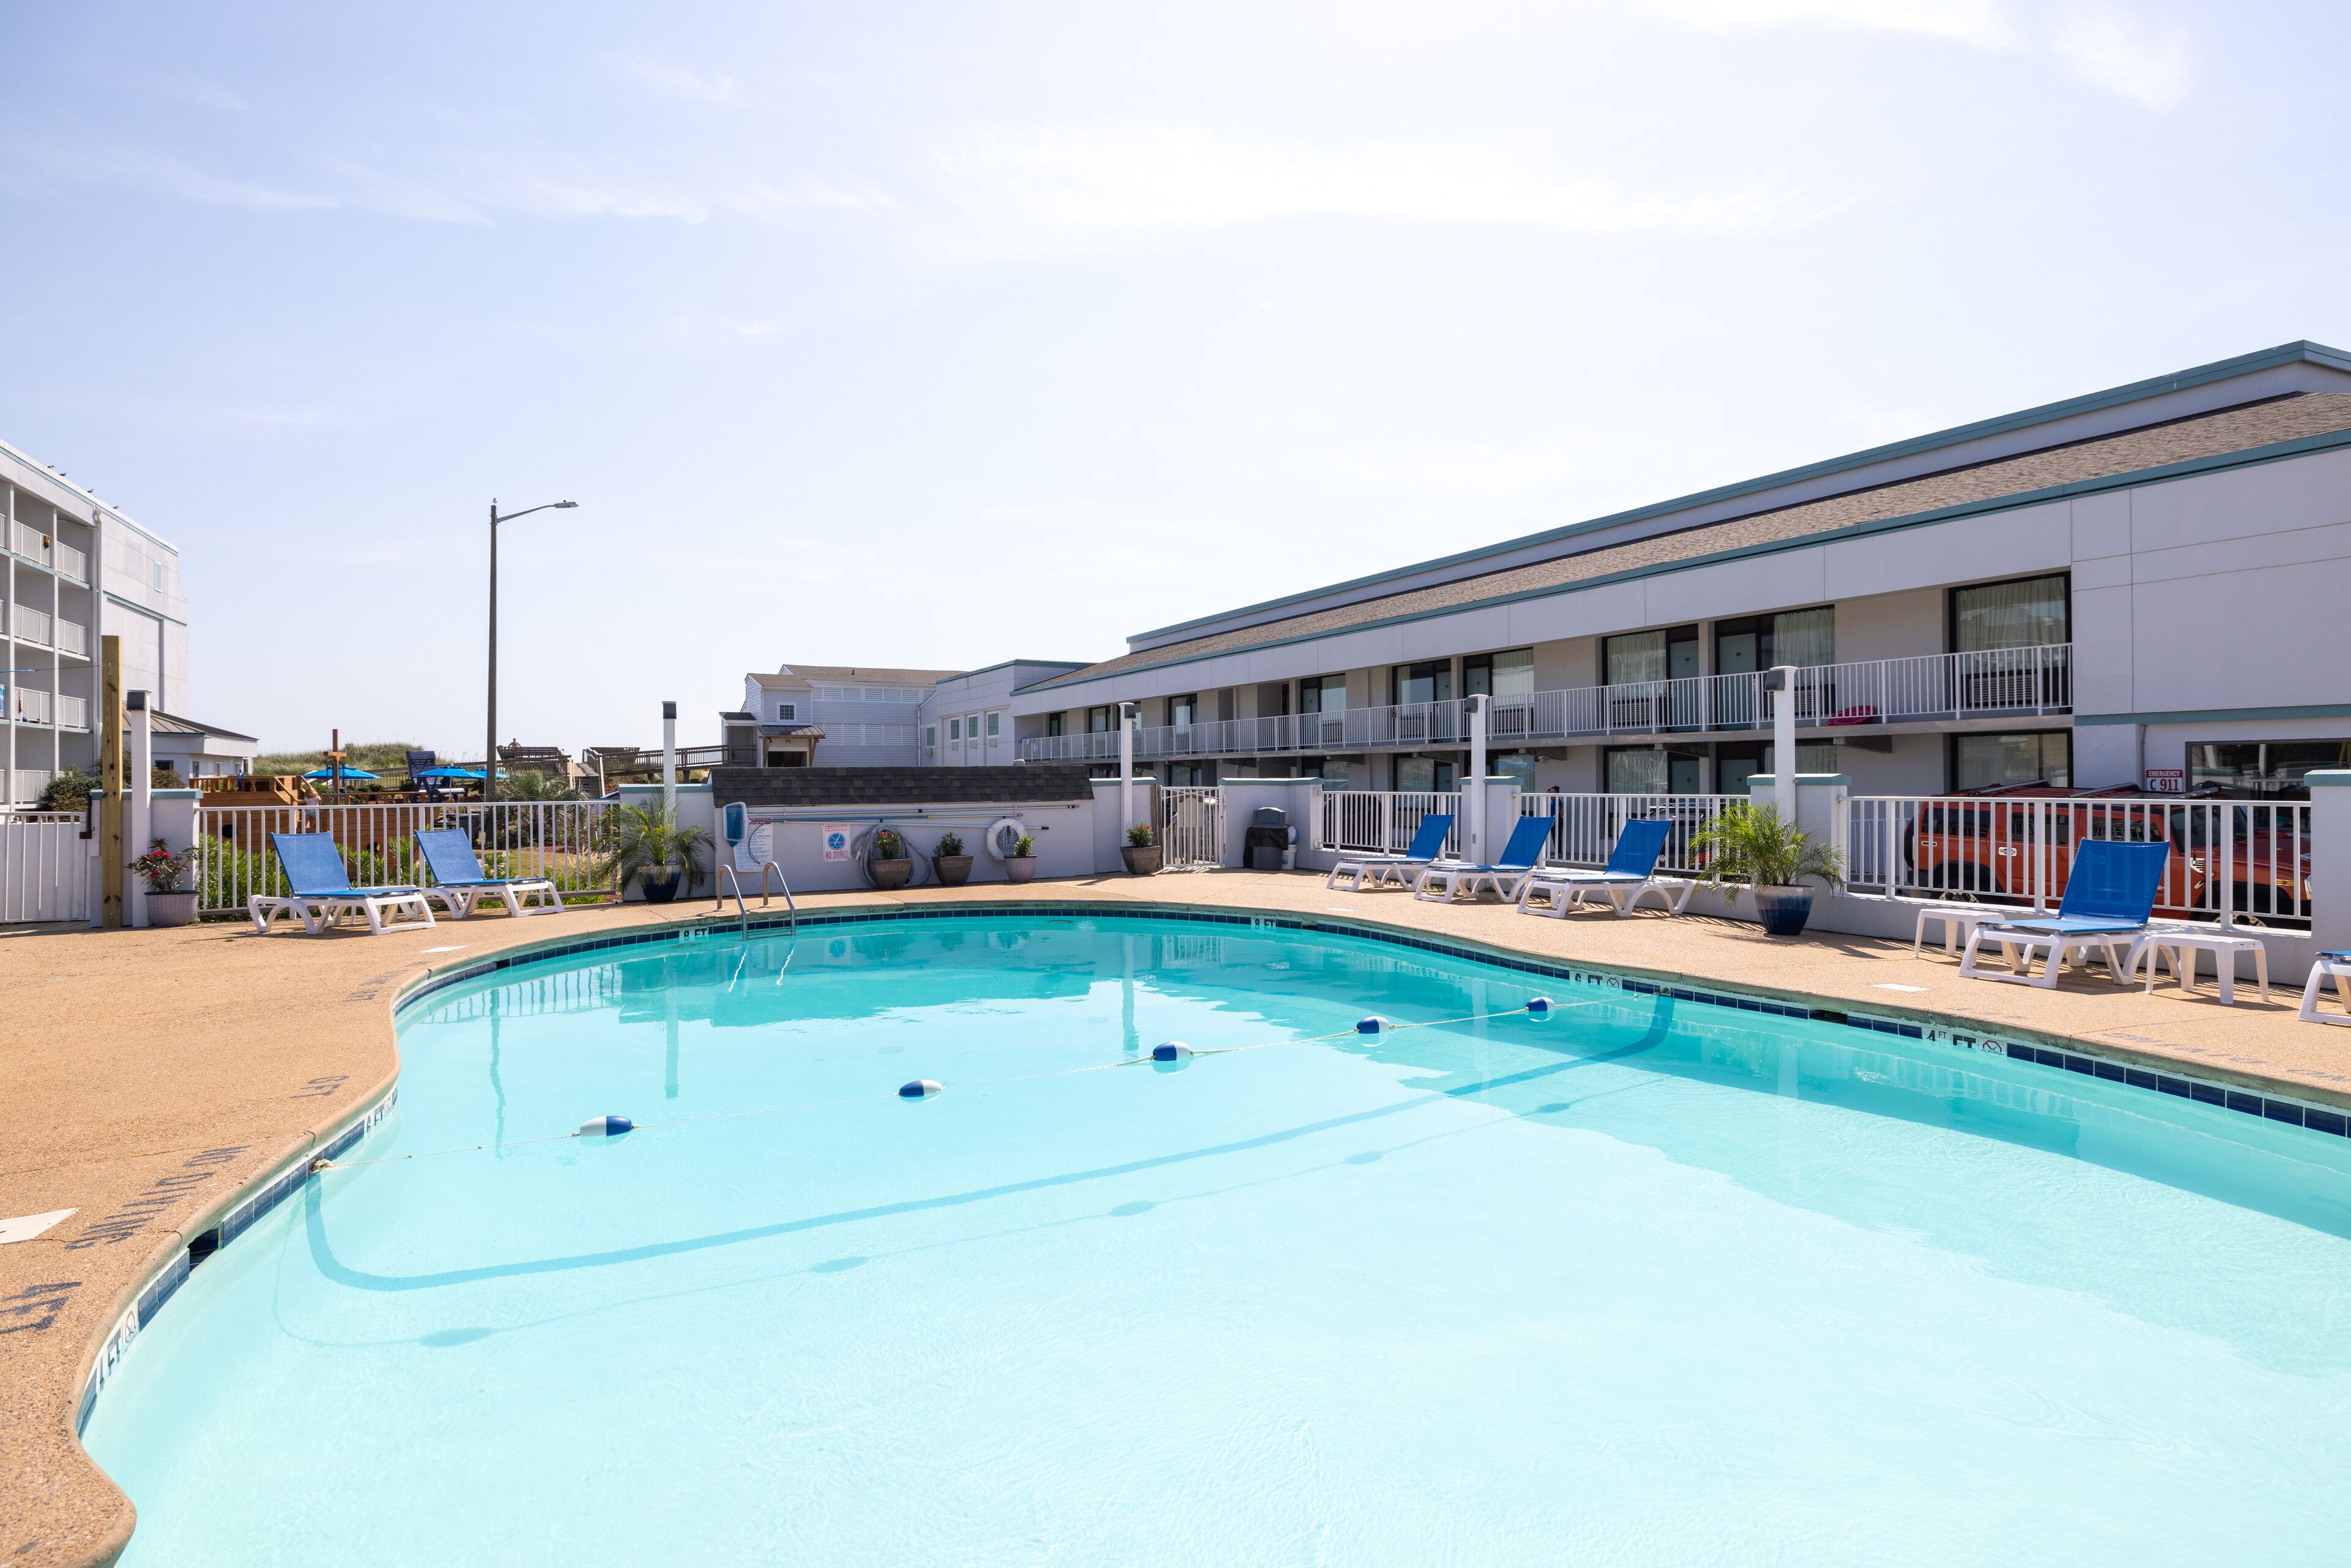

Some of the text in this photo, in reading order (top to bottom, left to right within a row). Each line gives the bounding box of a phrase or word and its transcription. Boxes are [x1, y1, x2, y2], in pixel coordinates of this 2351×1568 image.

[2160, 778, 2179, 791] 911
[825, 850, 849, 860] NO DIVING!
[1264, 918, 1275, 927] FT
[694, 928, 707, 937] FT
[1588, 974, 1603, 985] FT
[1927, 1030, 1936, 1041] 4
[1953, 1034, 1976, 1049] FT
[374, 1103, 384, 1126] FT
[107, 1327, 121, 1377] FT
